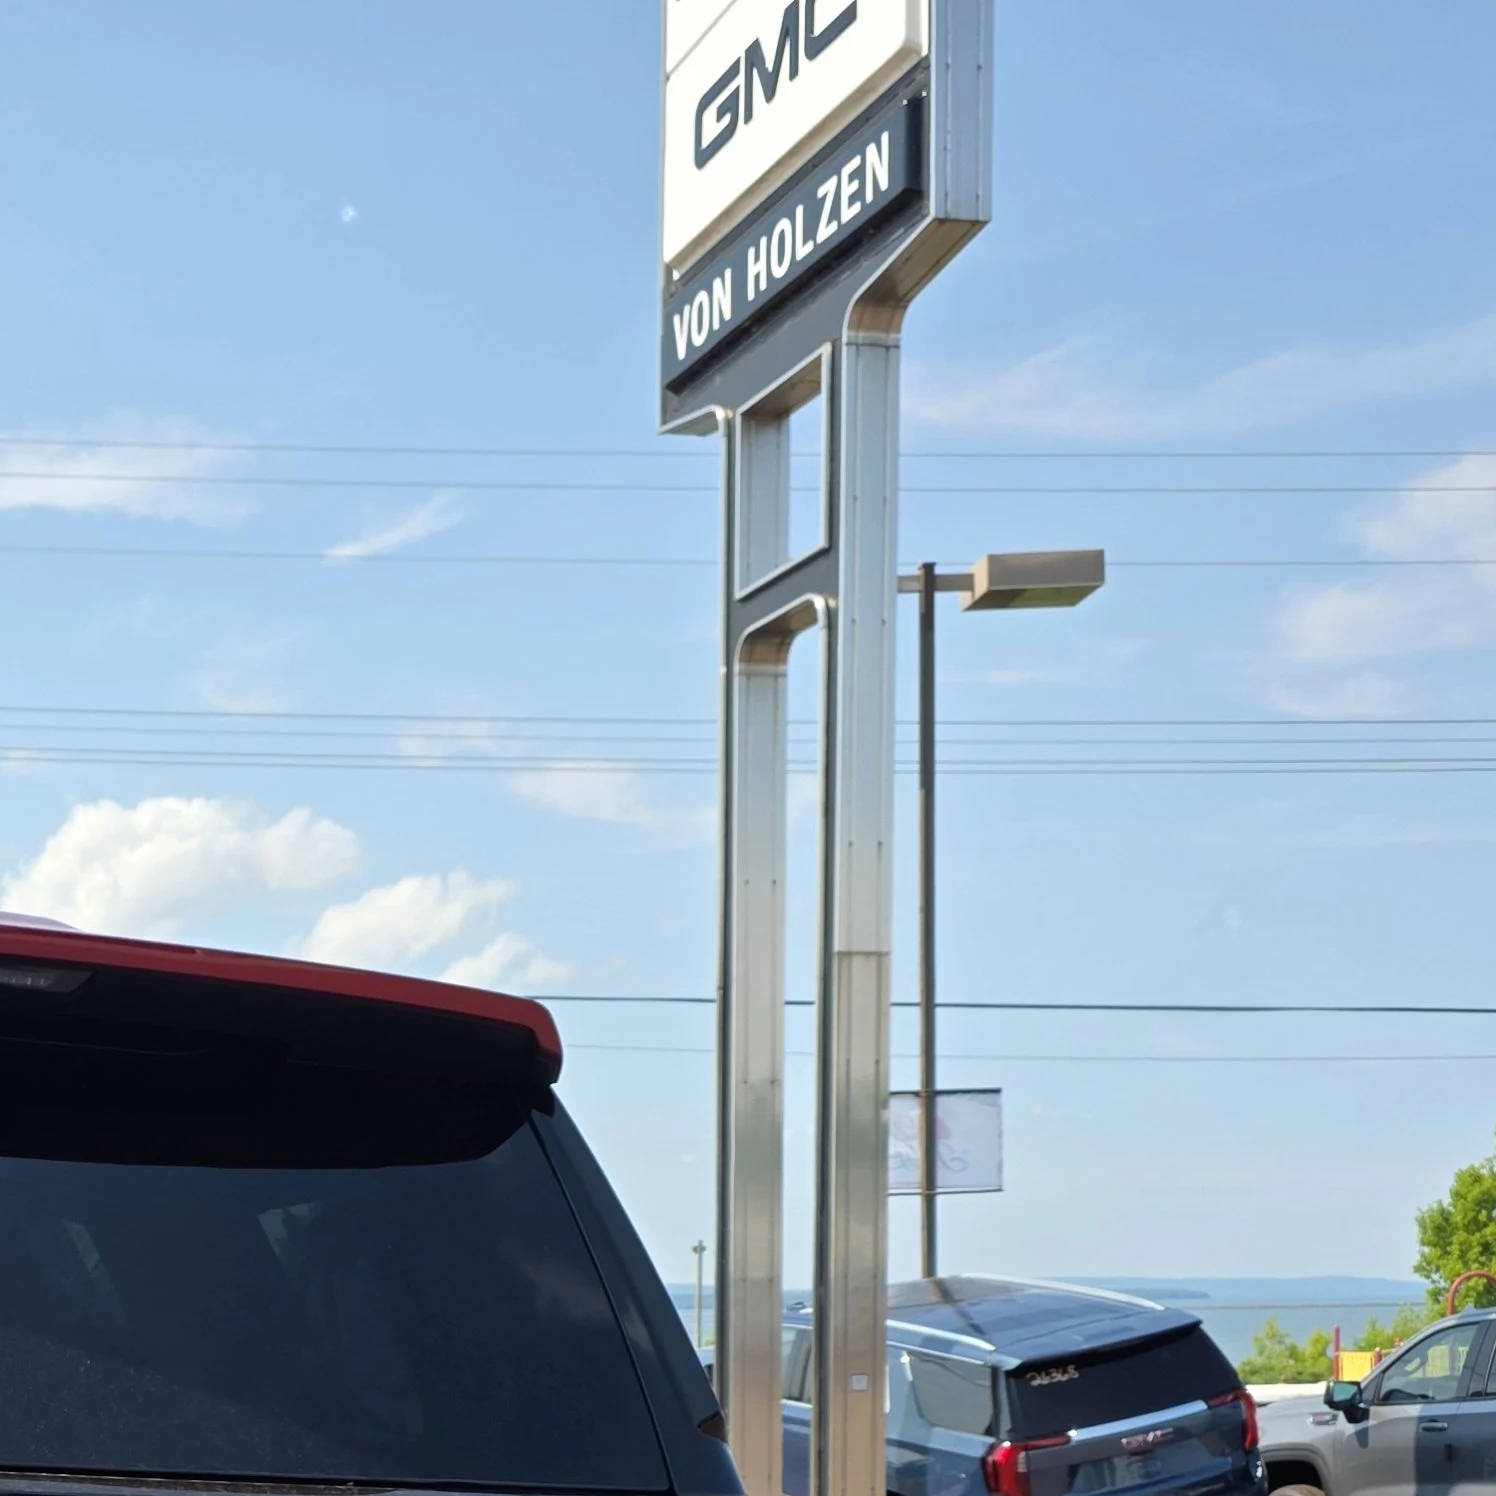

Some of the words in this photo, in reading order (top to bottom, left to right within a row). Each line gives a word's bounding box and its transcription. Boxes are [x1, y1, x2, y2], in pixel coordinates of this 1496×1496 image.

[694, 0, 858, 170] GMC
[672, 267, 733, 362] VON
[746, 130, 890, 302] HOLZEN
